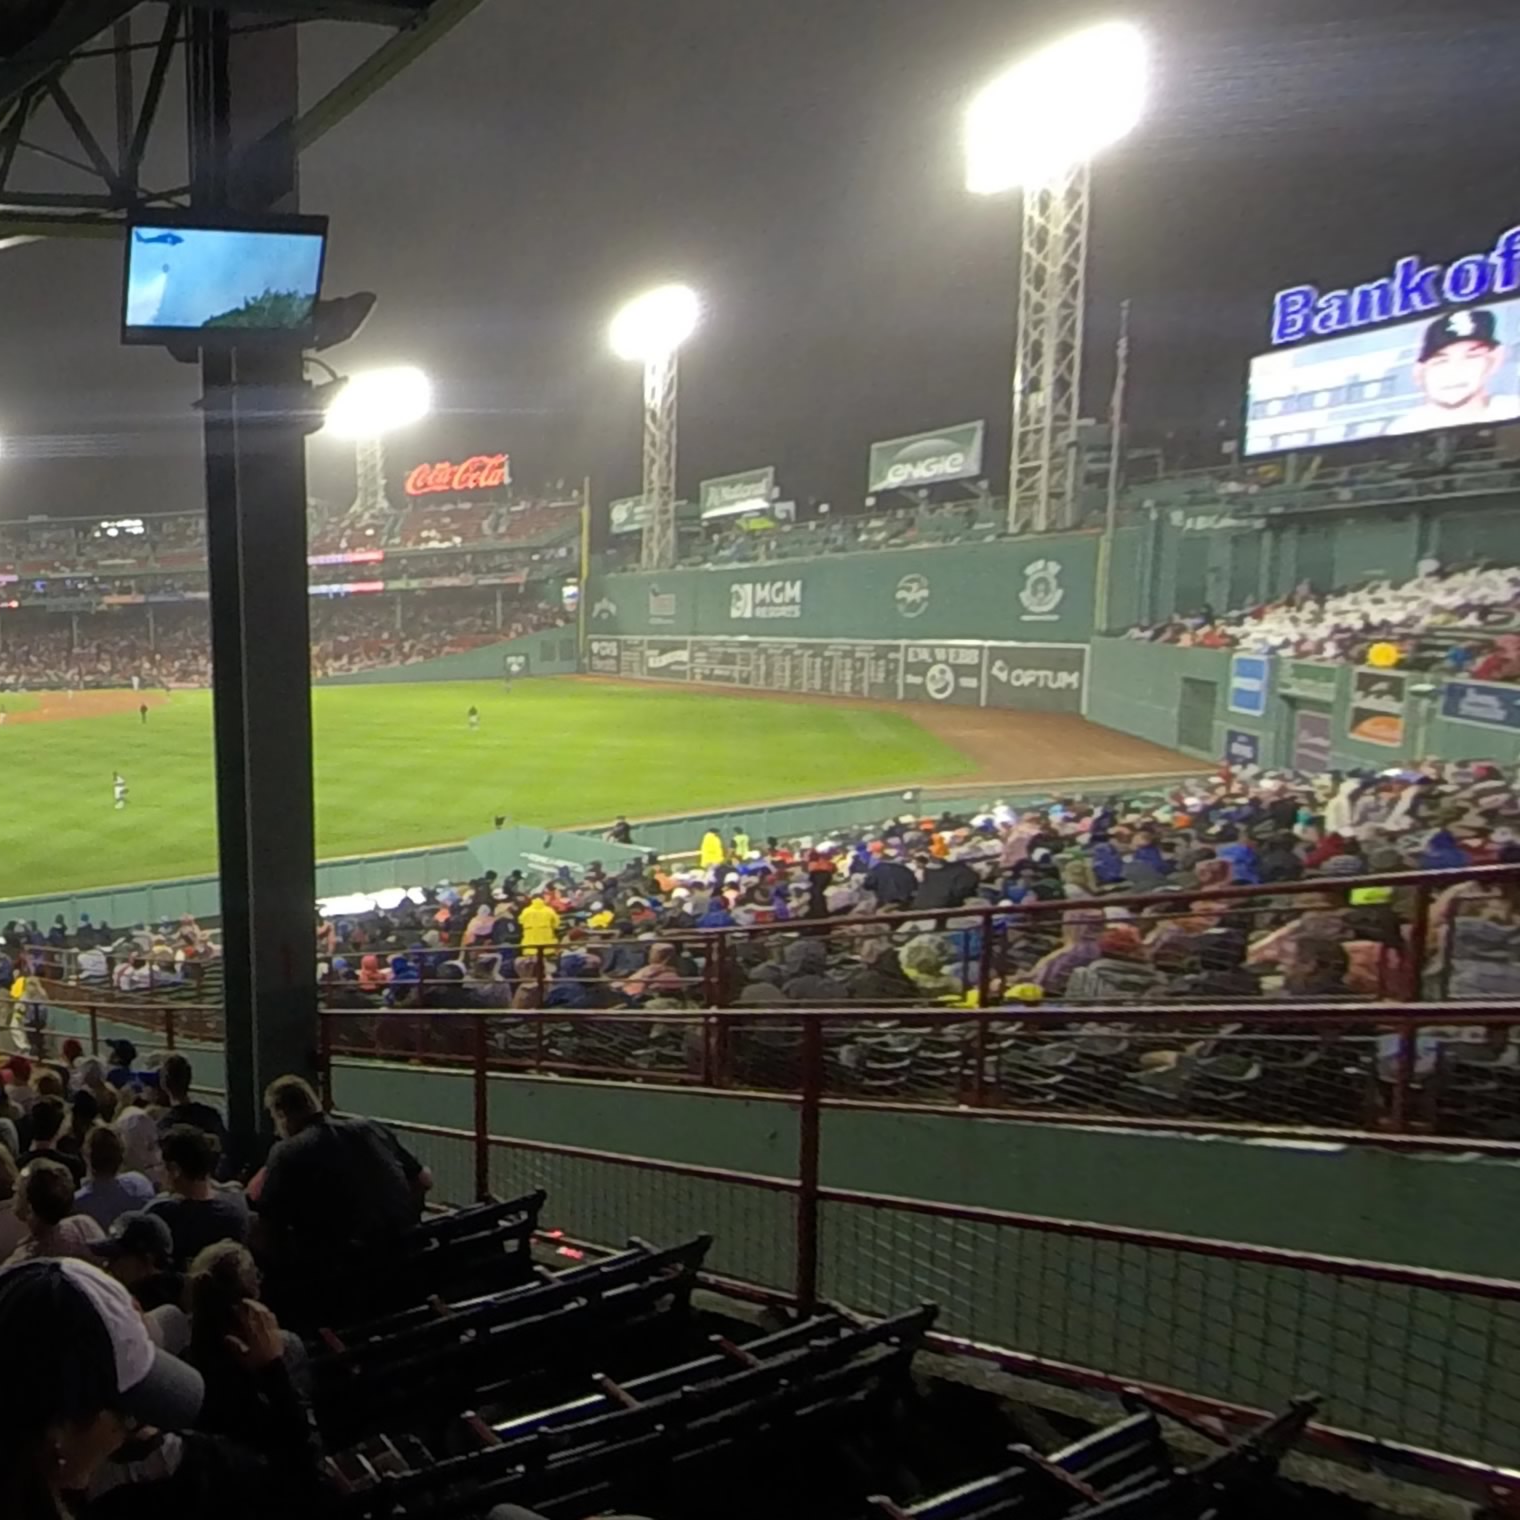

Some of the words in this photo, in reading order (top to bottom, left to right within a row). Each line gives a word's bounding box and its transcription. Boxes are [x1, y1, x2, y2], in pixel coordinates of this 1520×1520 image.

[1271, 256, 1441, 346] Bank
[1443, 225, 1520, 303] of
[754, 580, 802, 604] MGM
[1010, 668, 1080, 690] OPTUM
